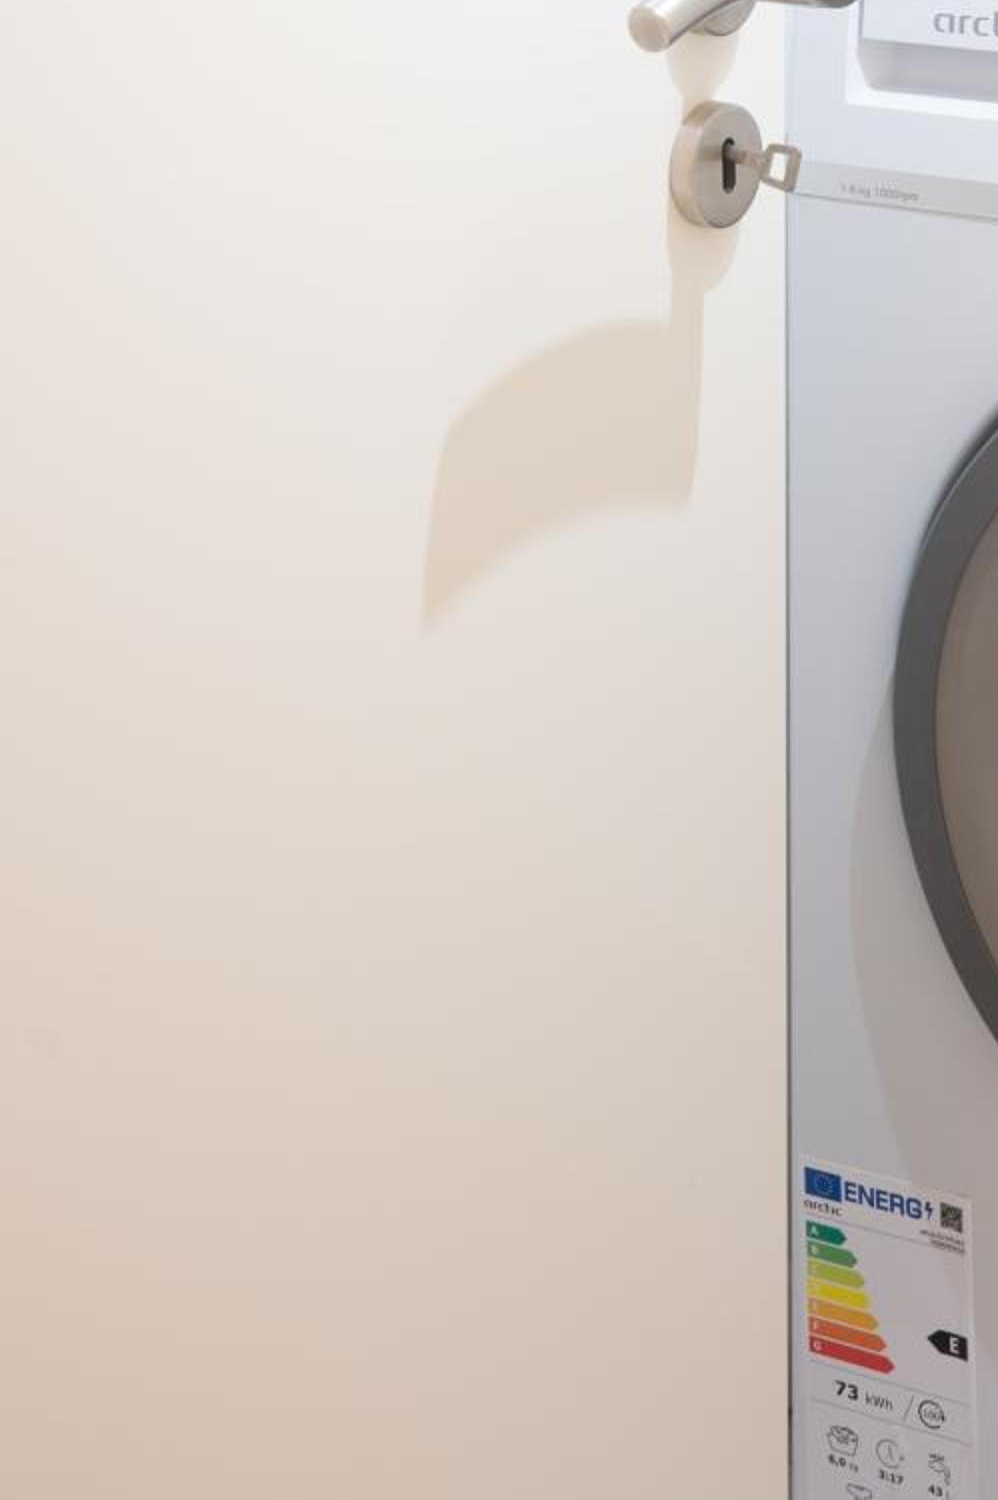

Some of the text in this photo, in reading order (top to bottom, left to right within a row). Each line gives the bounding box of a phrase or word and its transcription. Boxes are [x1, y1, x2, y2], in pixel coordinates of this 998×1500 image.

[803, 1200, 843, 1217] arctic
[844, 1179, 923, 1220] ENERG
[949, 1336, 960, 1356] E
[834, 1379, 859, 1401] 73
[865, 1391, 893, 1411] kWh
